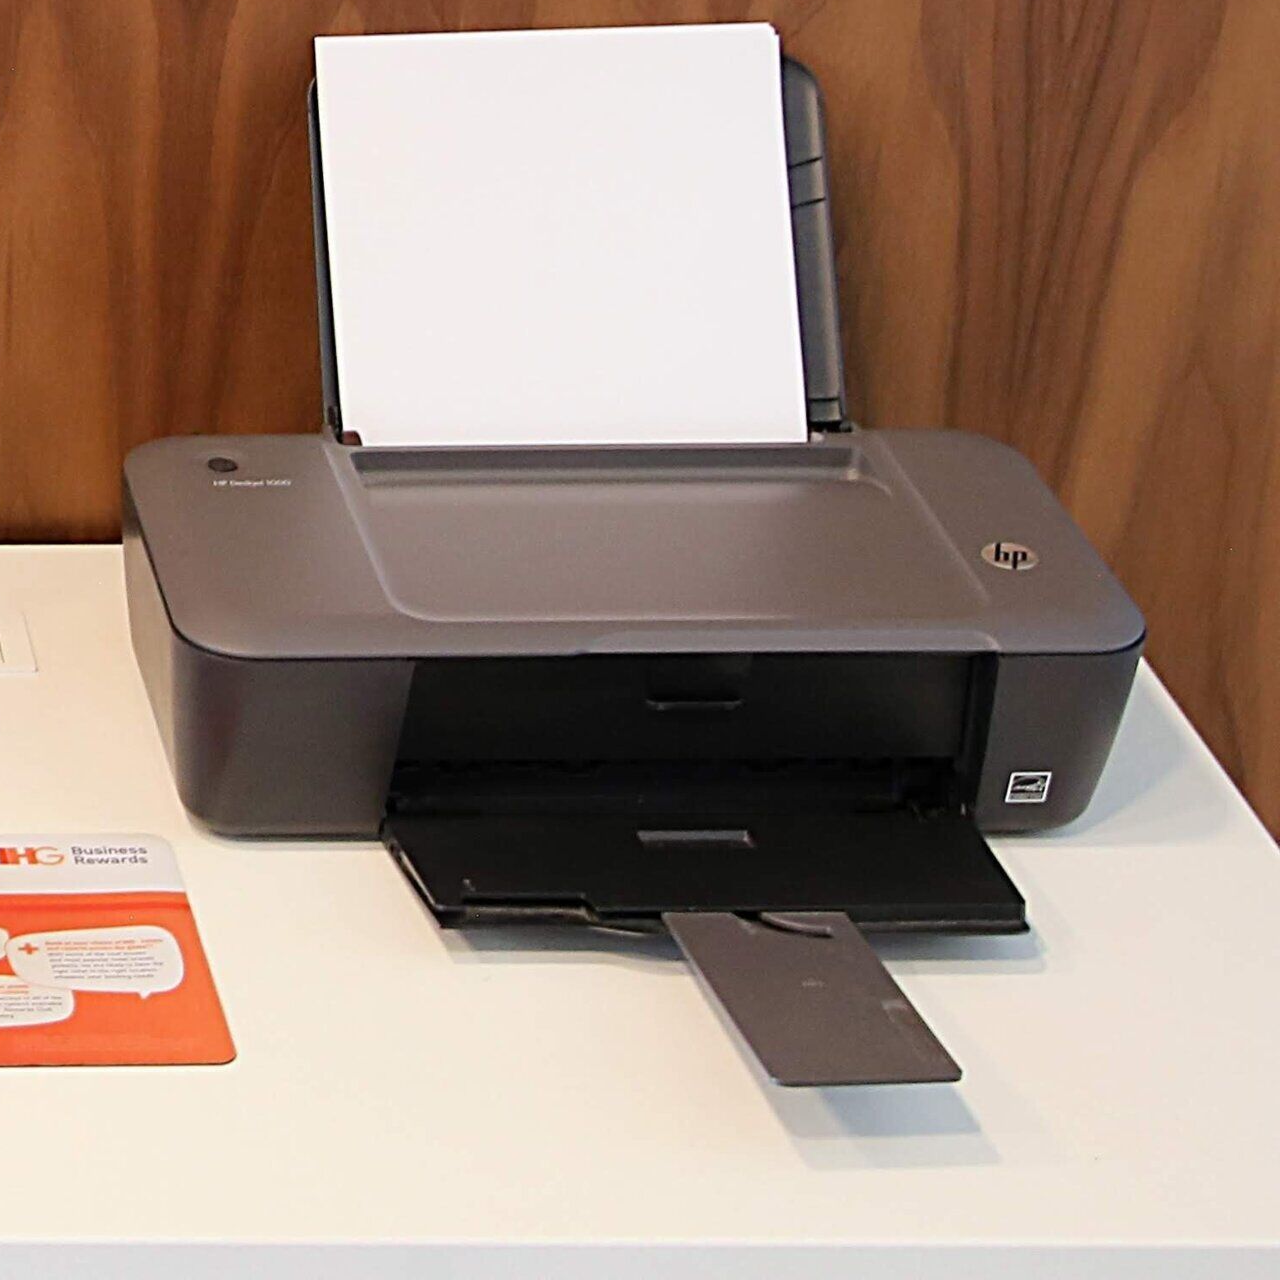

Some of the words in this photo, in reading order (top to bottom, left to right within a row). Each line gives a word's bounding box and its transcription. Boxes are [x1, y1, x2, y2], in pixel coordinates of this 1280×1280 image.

[995, 542, 1027, 569] hp
[71, 846, 148, 855] Business
[74, 855, 148, 865] Rewards
